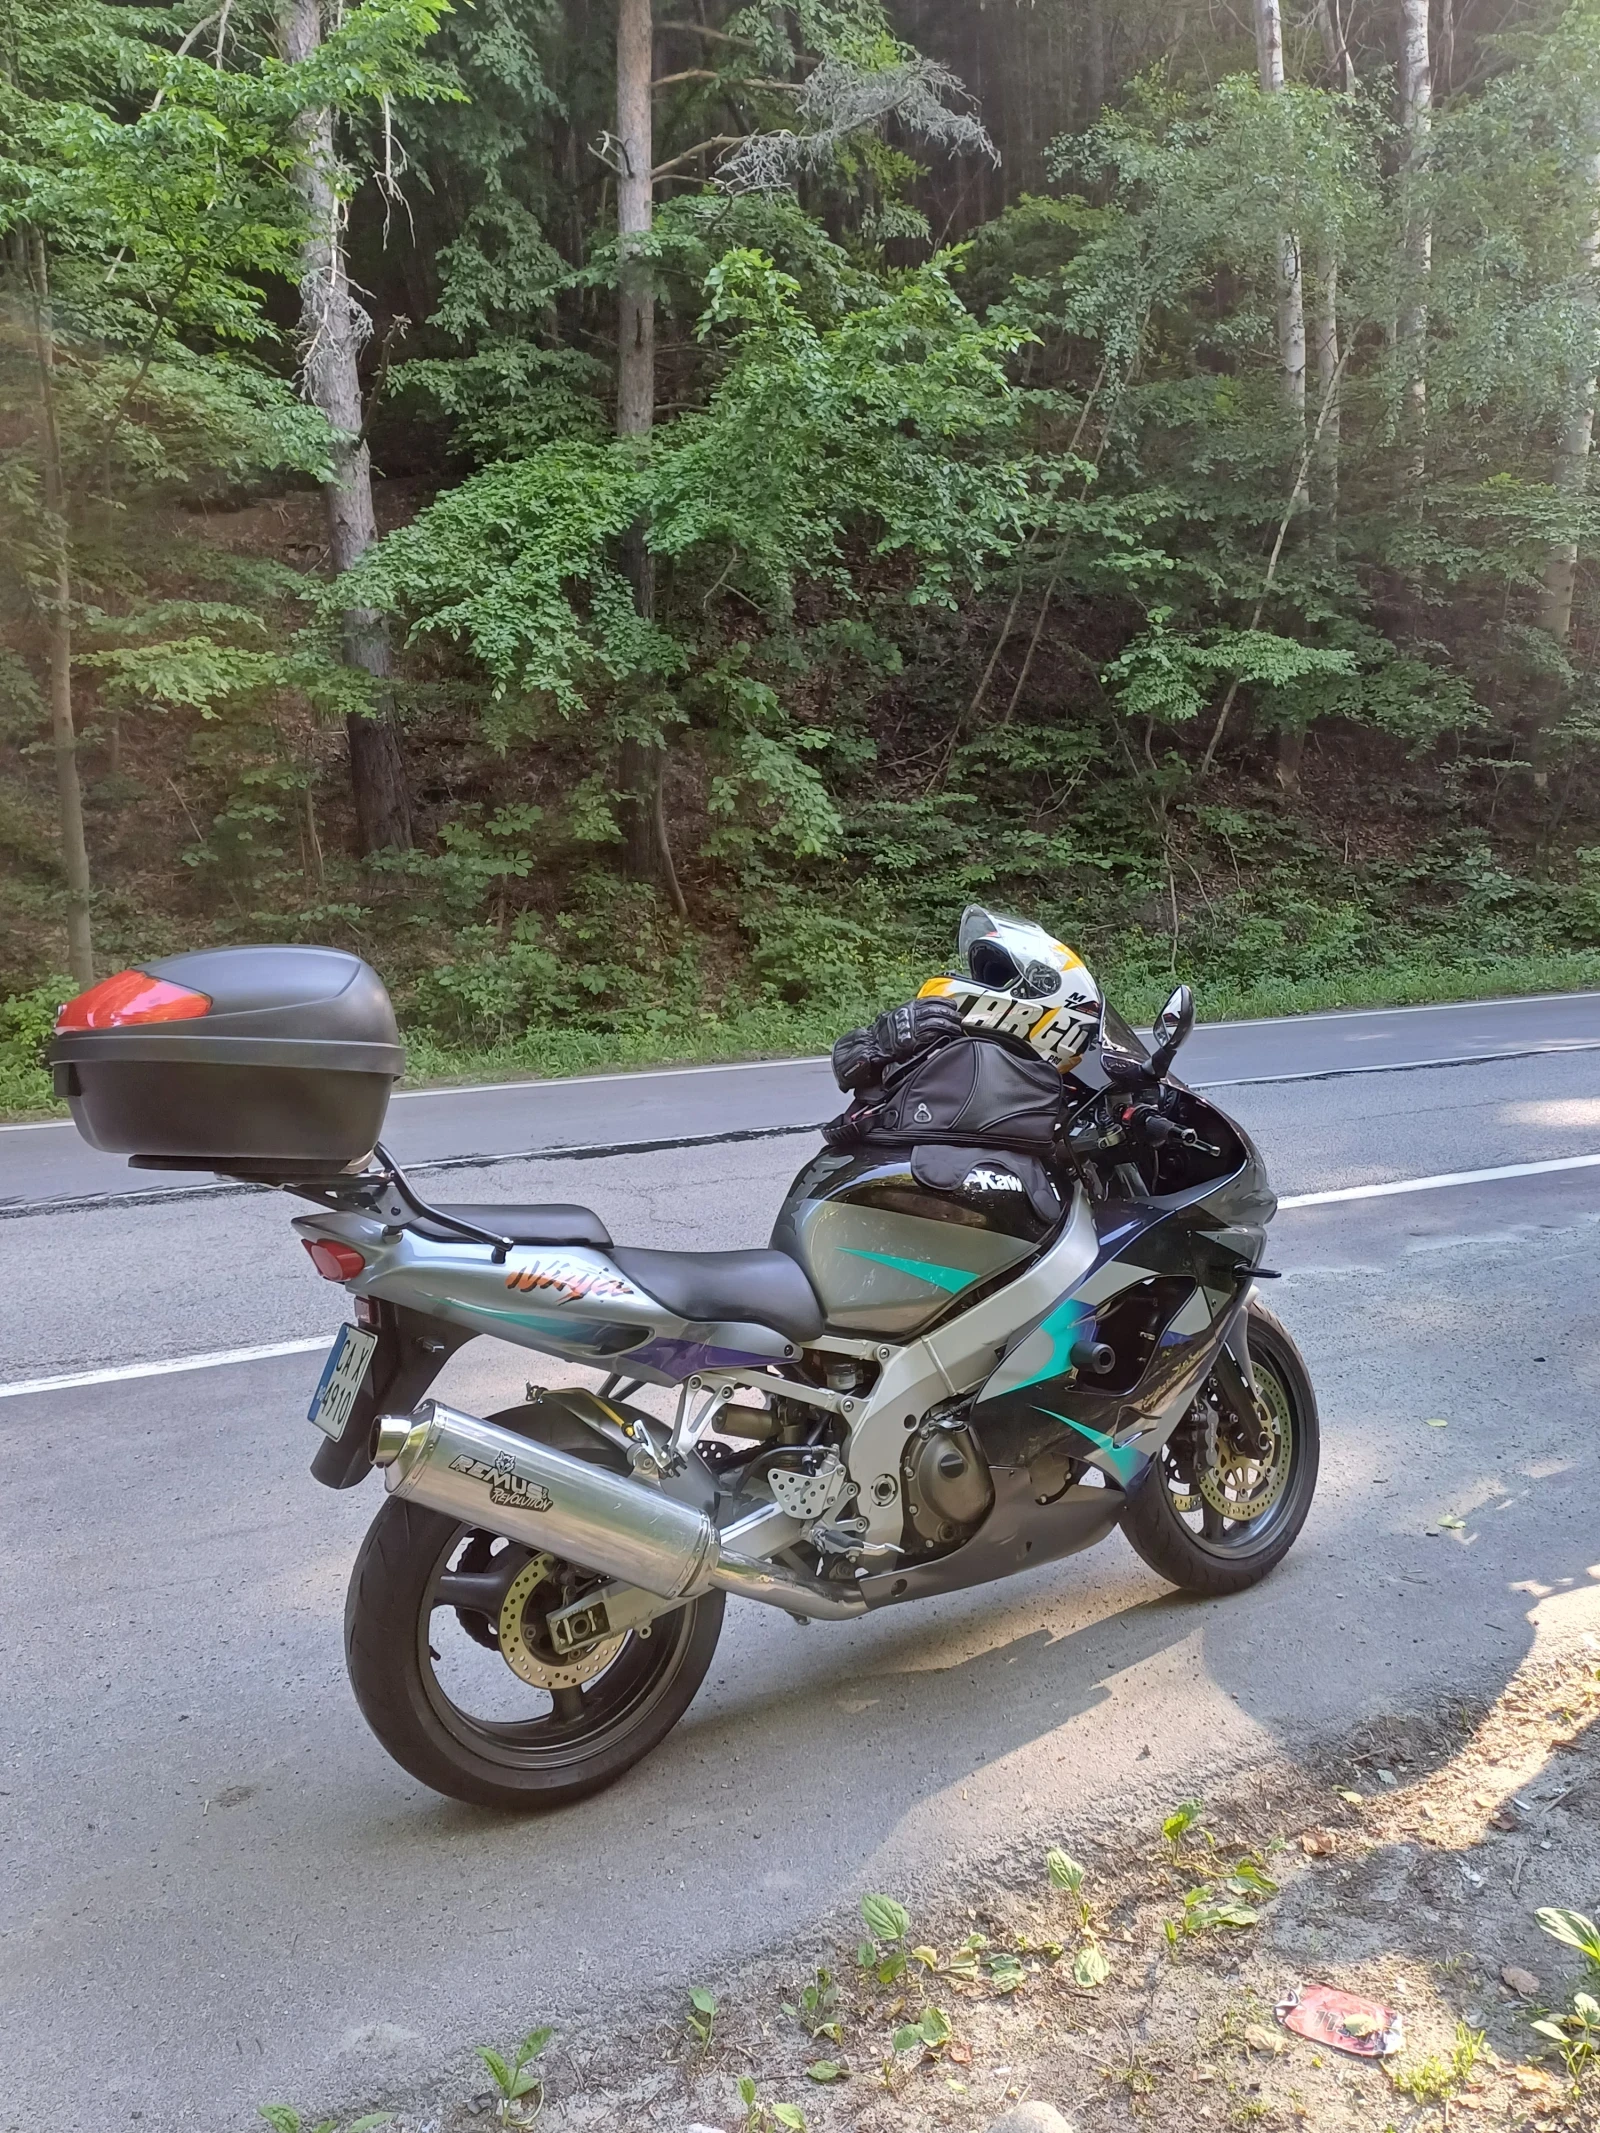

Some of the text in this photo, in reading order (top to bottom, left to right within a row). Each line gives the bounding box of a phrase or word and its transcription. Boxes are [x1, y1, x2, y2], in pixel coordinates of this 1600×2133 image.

[505, 1260, 635, 1307] Ninja
[336, 1339, 369, 1383] CA X
[321, 1381, 352, 1425] 4910
[450, 1453, 543, 1499] REMUS
[491, 1487, 554, 1511] REVOLUTION
